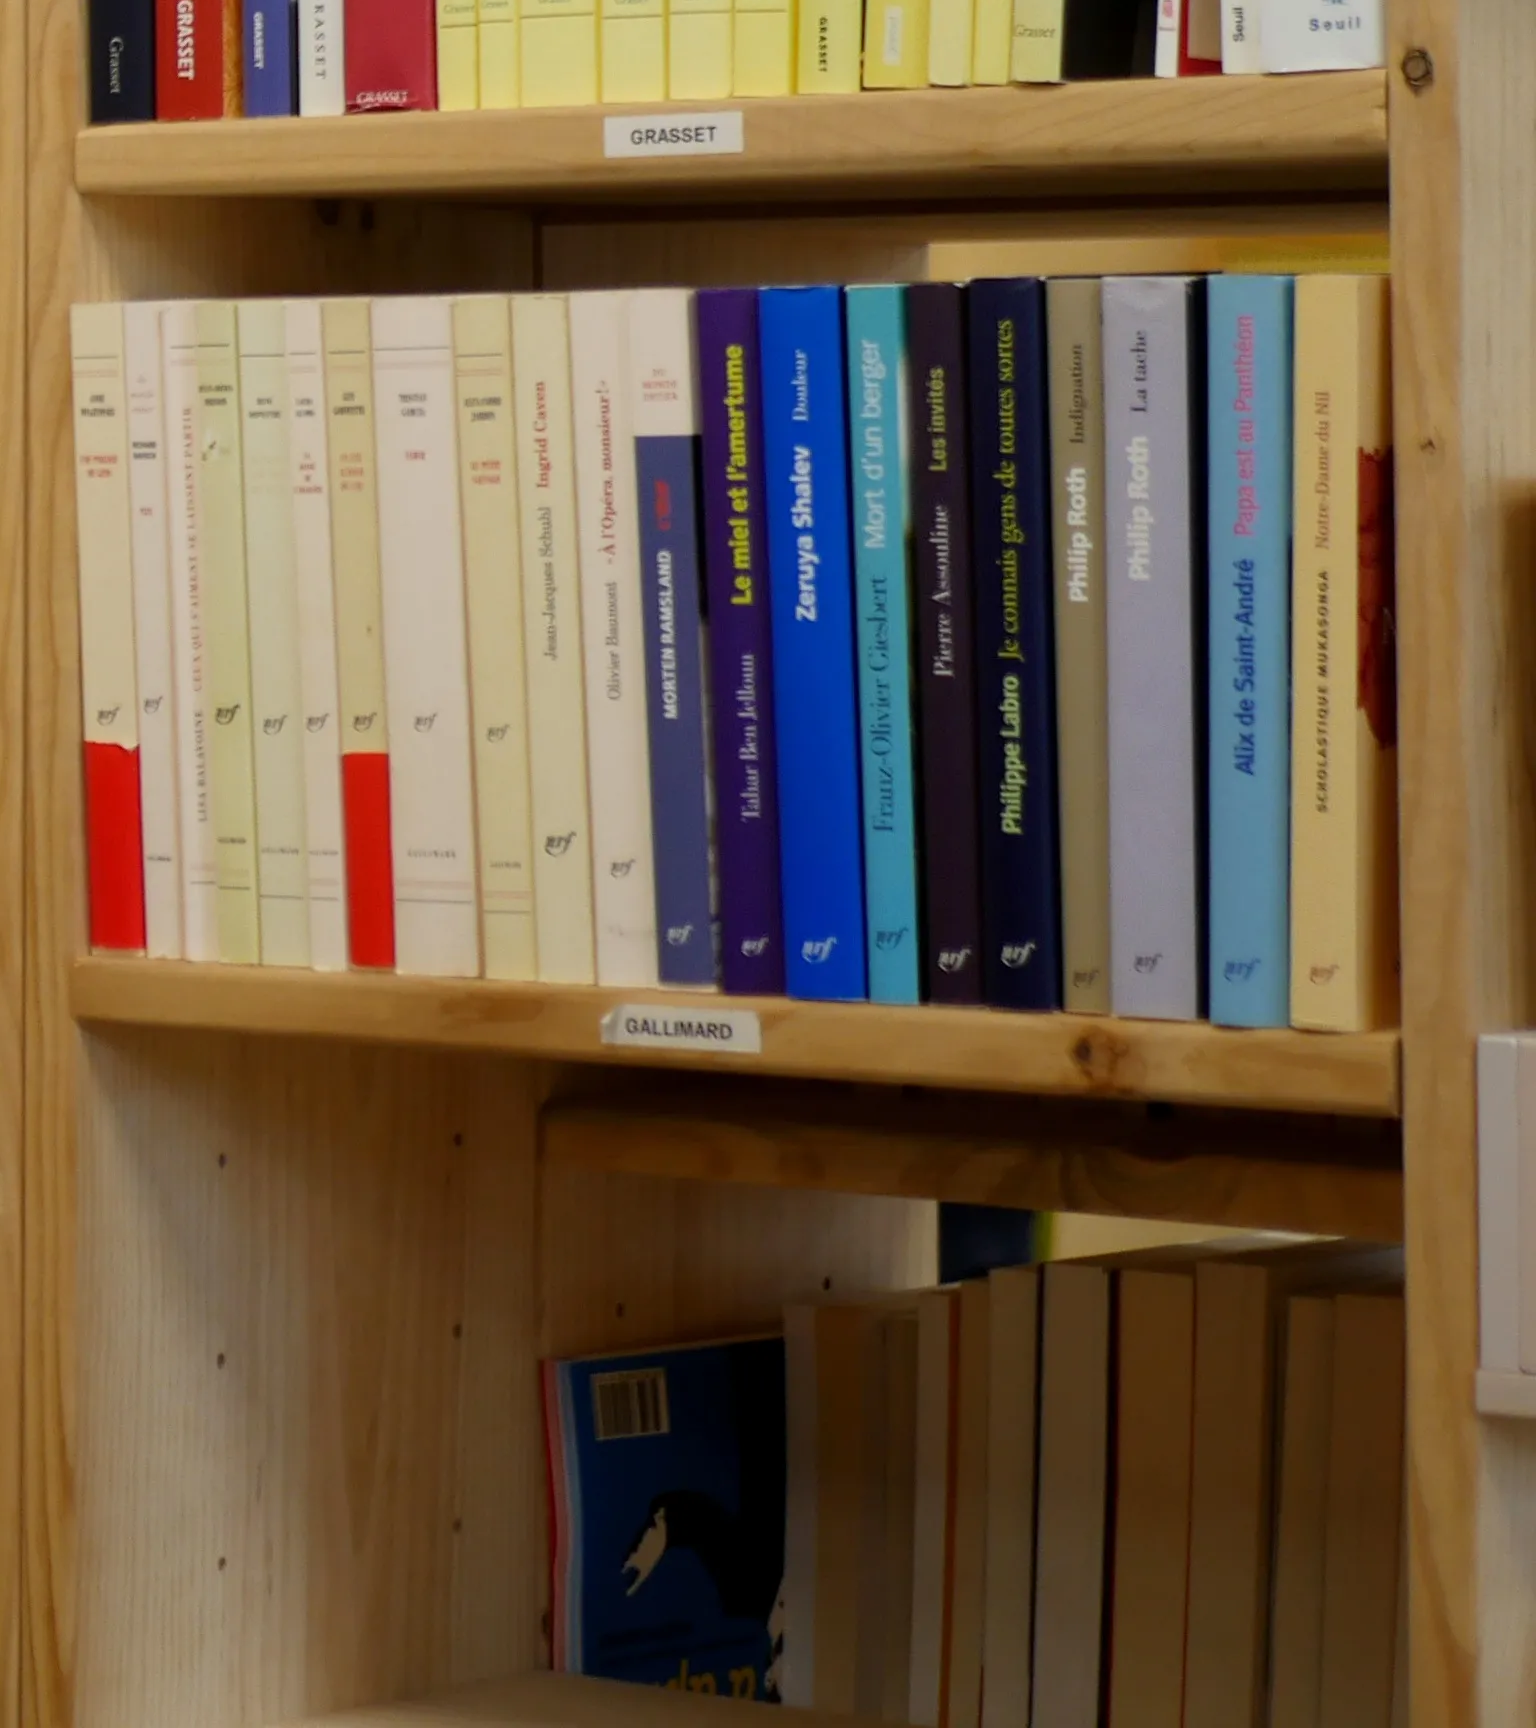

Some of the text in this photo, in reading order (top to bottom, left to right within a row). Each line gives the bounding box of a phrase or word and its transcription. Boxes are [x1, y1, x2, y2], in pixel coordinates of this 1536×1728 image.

[176, 0, 194, 80] GRASSET
[631, 125, 717, 147] GRASSET
[724, 343, 752, 605] Le miel et l'amertume
[861, 339, 887, 550] Mort d'un berger
[1127, 435, 1153, 582] Philip Roth
[789, 446, 820, 622] Zeruya Shalev
[1067, 467, 1093, 603] Philip Roth
[998, 675, 1026, 834] Philippe Labro
[625, 1017, 733, 1041] GALLIMARD
